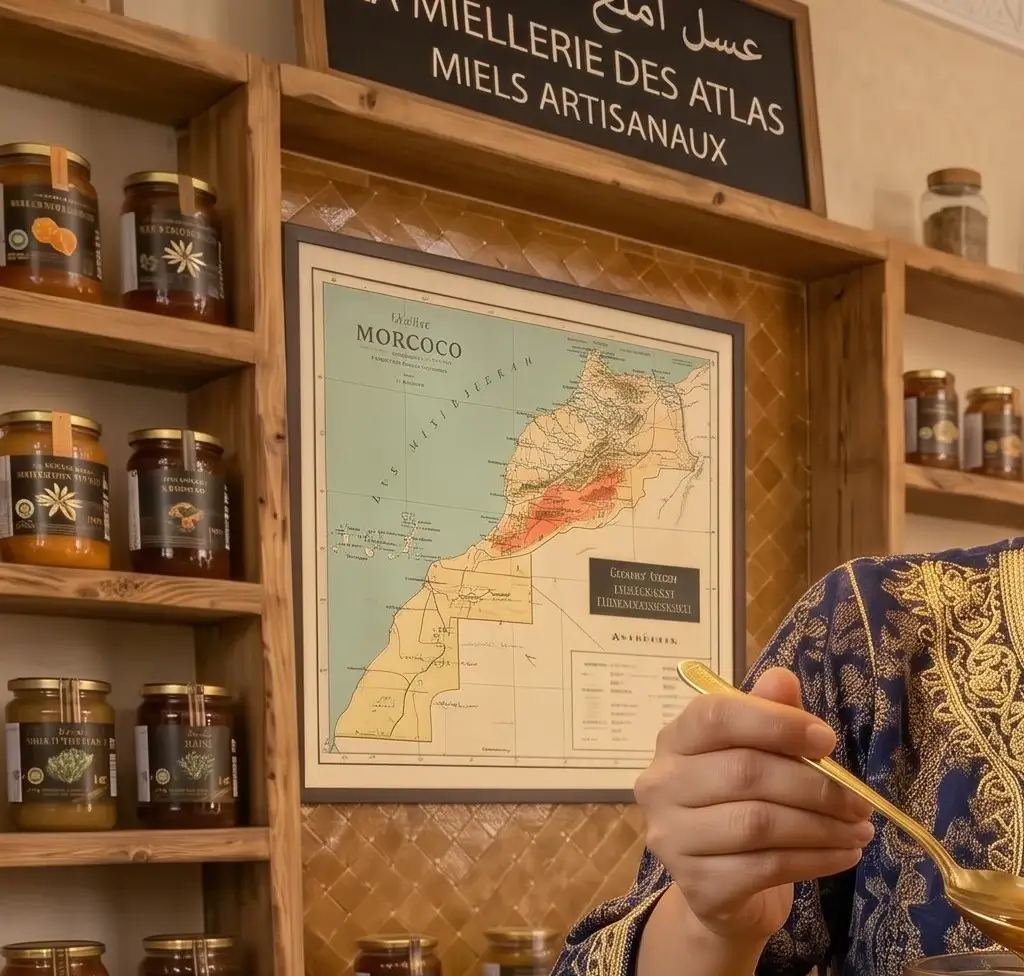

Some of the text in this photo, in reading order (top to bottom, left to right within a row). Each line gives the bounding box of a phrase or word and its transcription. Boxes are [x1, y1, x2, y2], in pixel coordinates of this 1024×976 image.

[414, 0, 785, 136] MIELLERIE DES ATLAS
[682, 8, 763, 61] عسل
[432, 47, 728, 166] MIELS ARTISANAUX
[356, 324, 462, 358] MORCOCO
